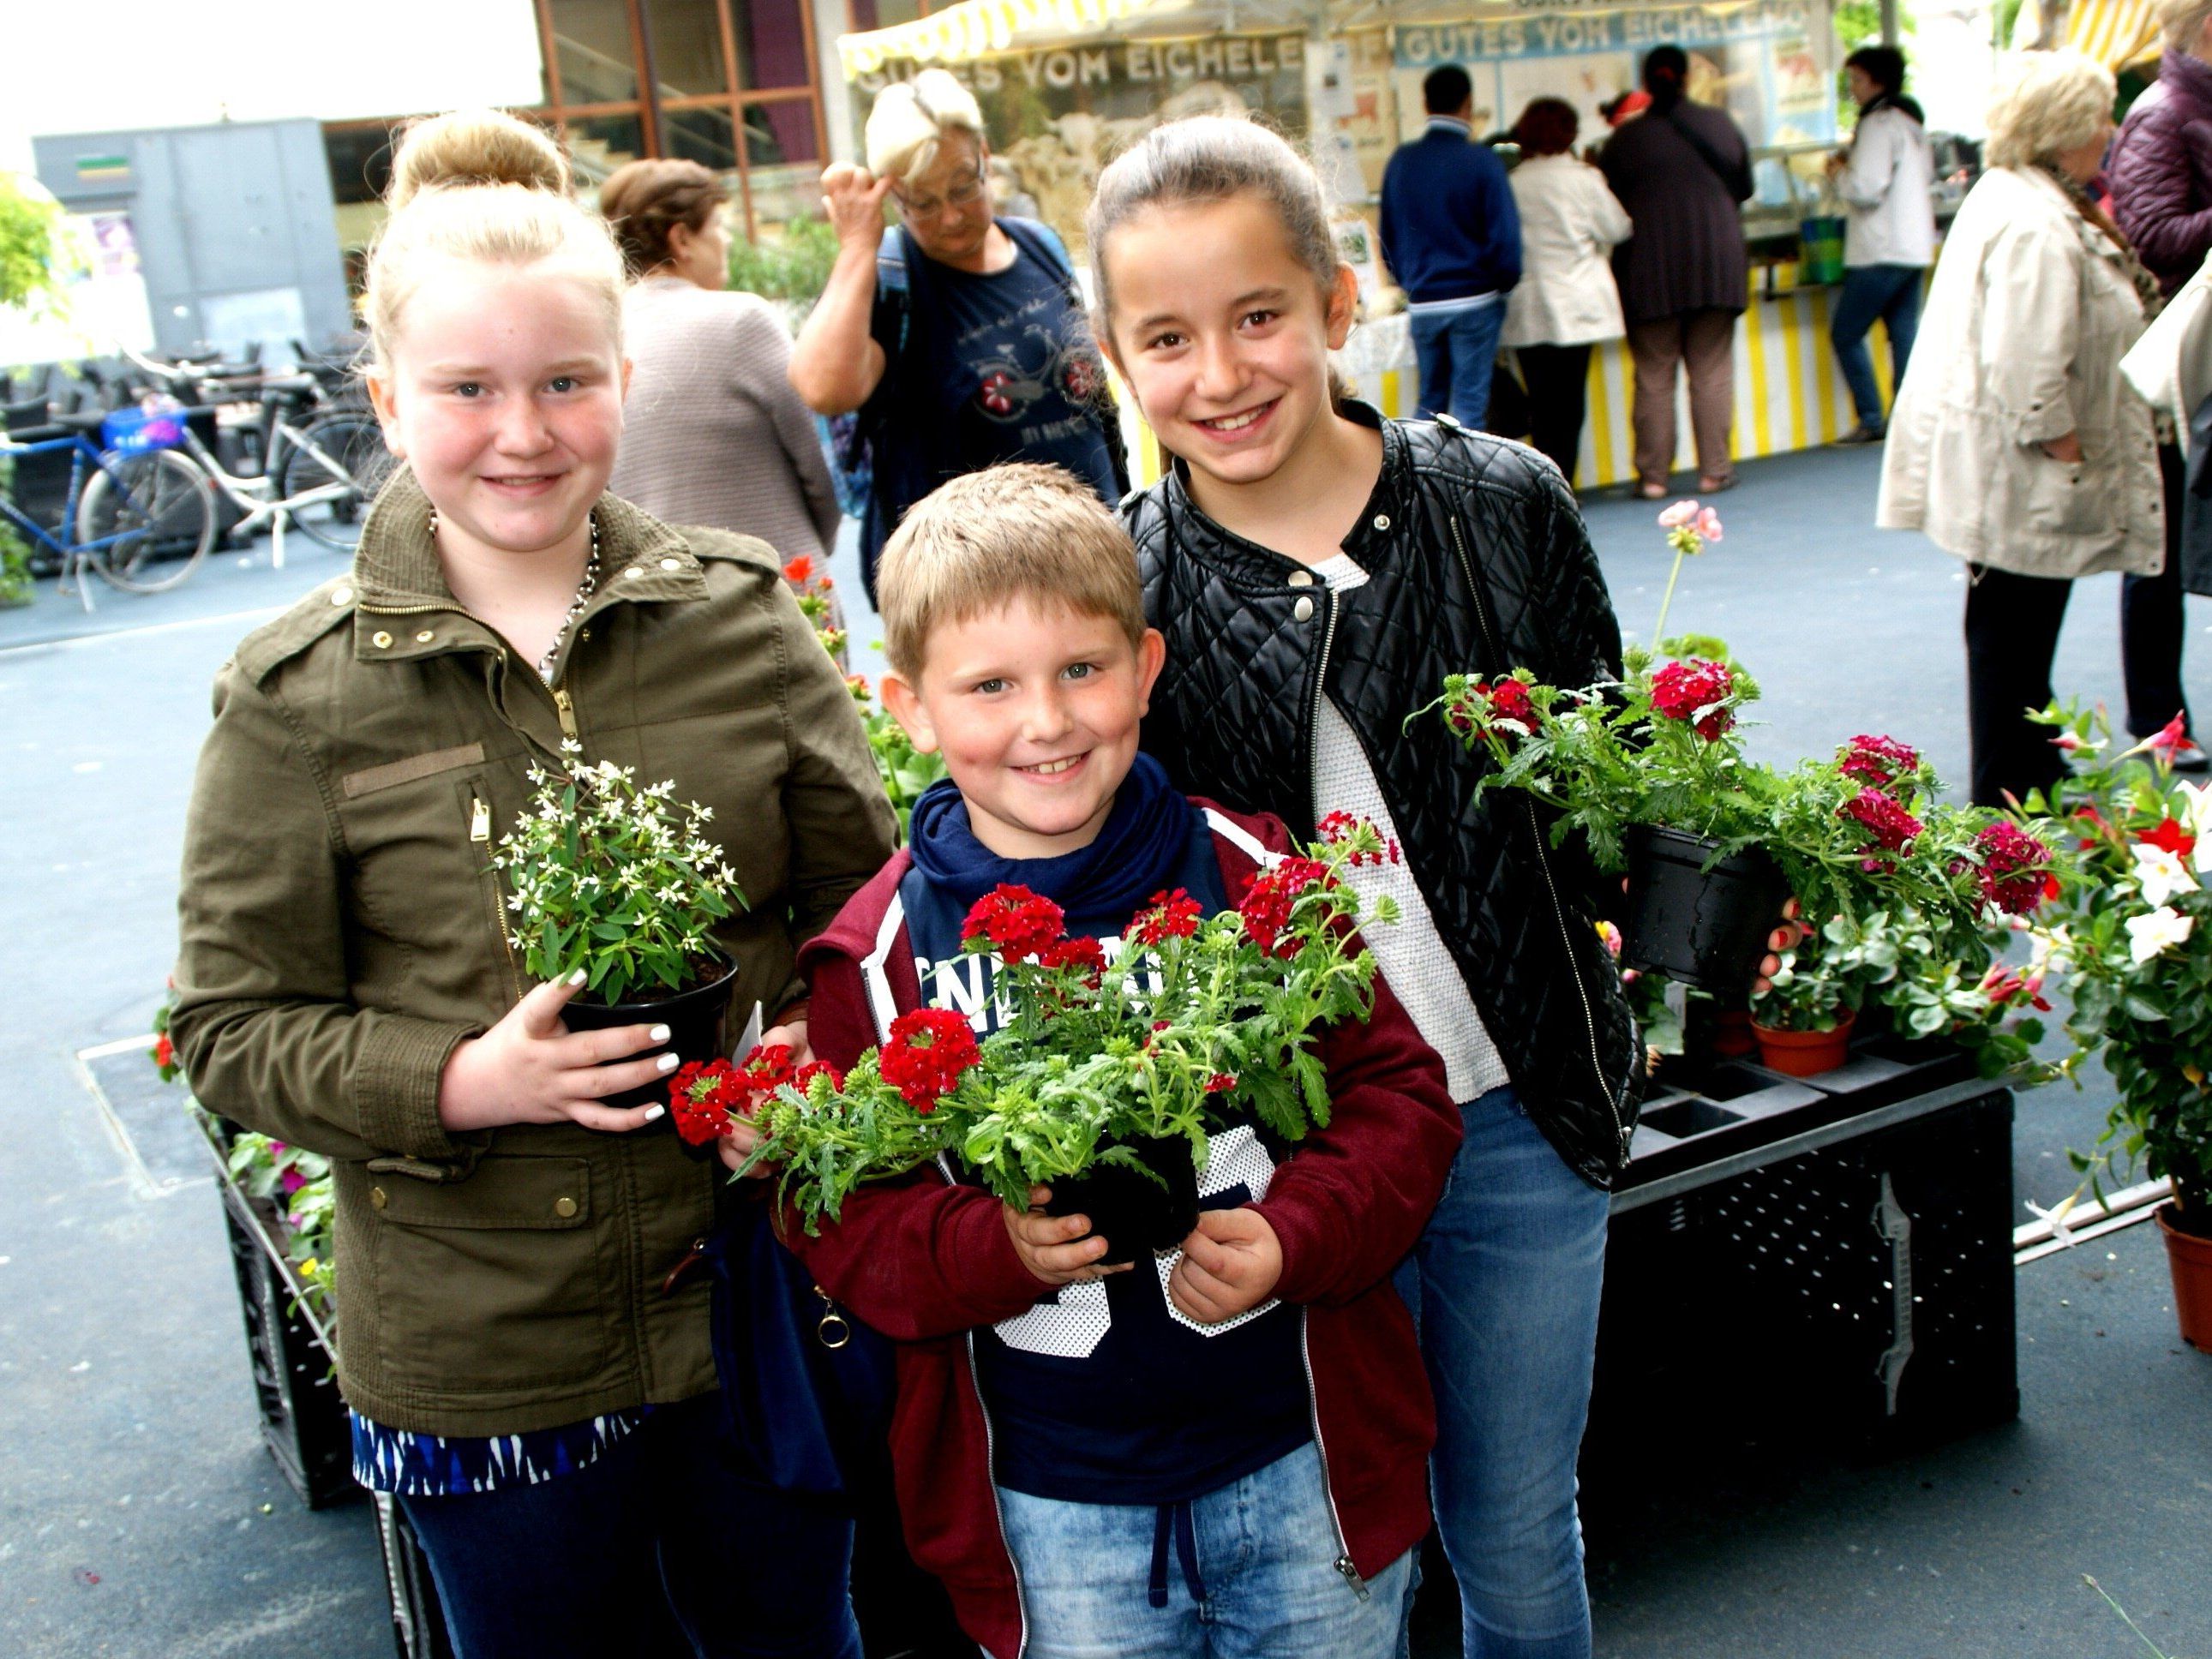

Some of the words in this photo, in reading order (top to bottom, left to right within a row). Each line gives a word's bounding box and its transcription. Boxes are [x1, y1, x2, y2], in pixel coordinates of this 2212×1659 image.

[1404, 21, 1527, 62] GUTES
[1538, 15, 1610, 50] VOM
[1017, 48, 1110, 89] VOM
